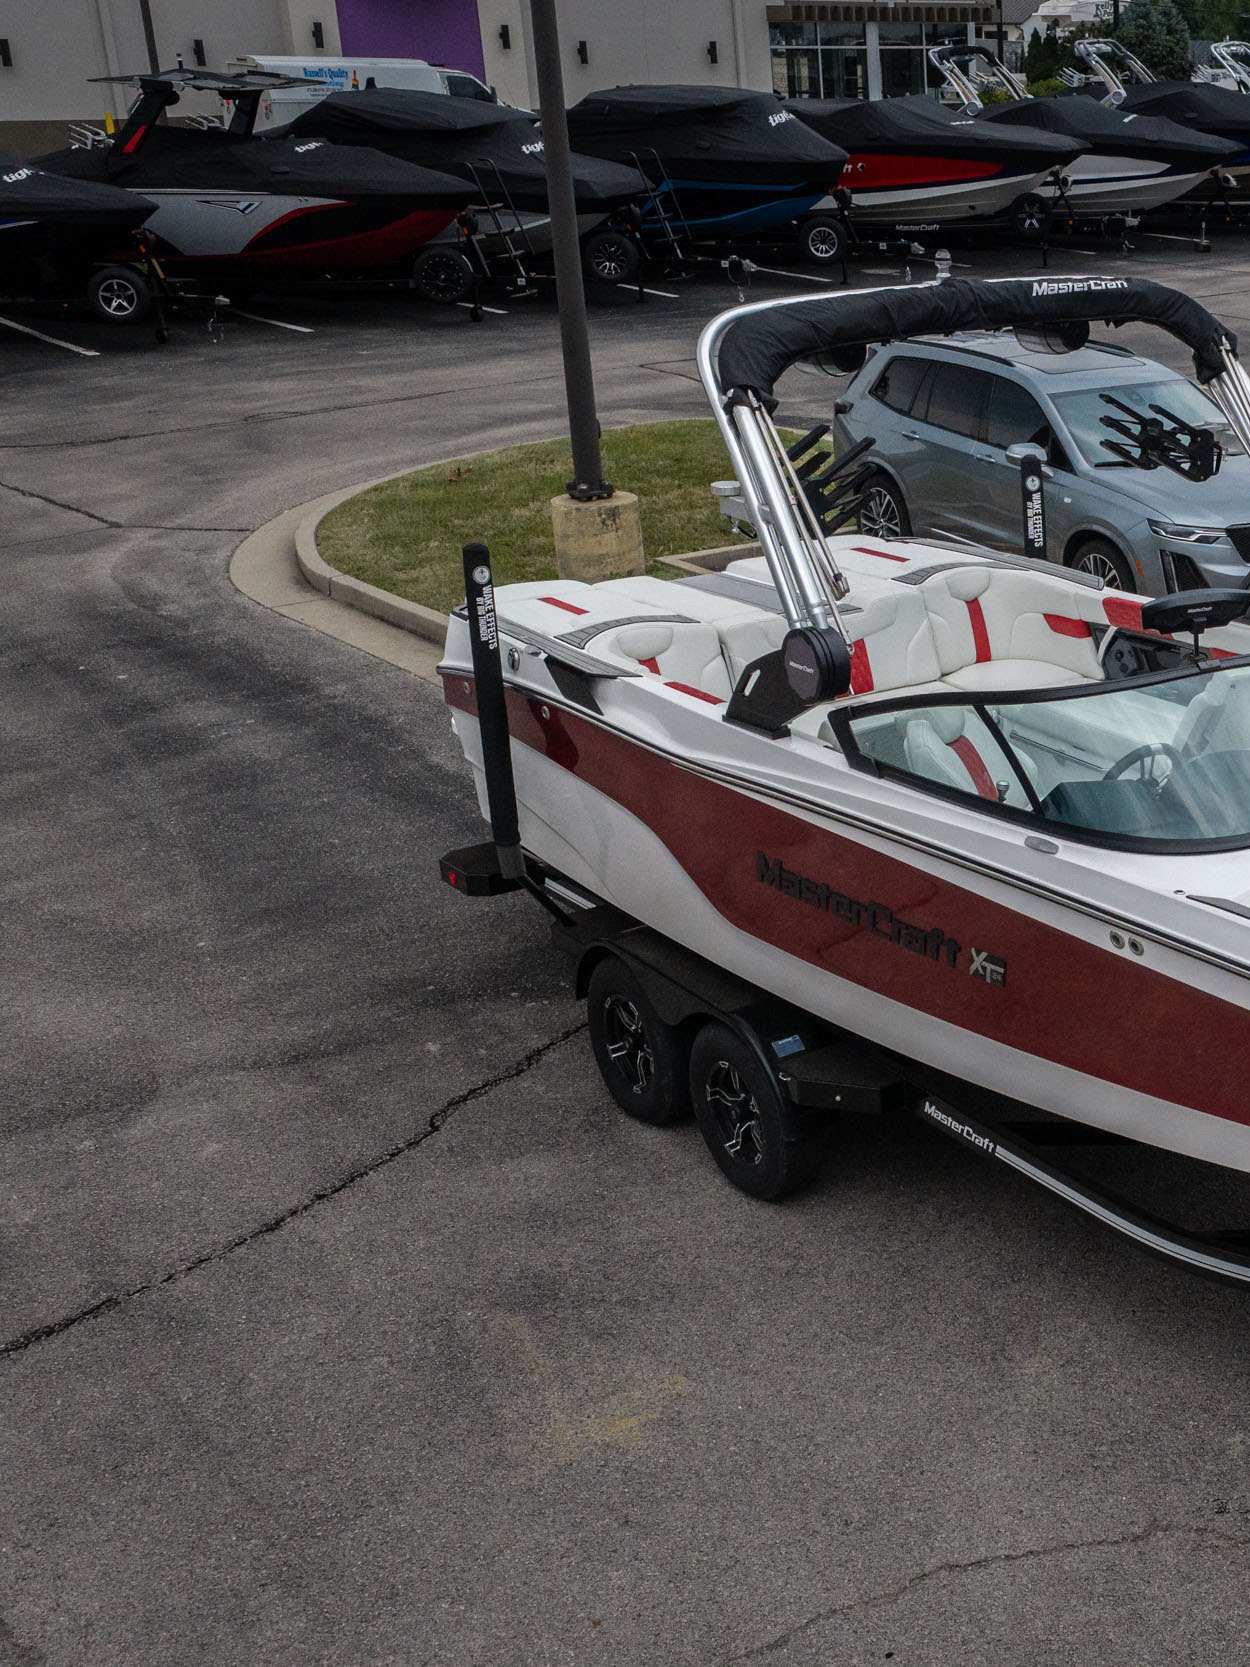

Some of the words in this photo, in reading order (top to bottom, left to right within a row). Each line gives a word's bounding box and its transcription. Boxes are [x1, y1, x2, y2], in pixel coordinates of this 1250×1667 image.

[1031, 492, 1042, 514] WAKE
[1033, 515, 1043, 547] EFFECTS
[475, 597, 484, 605] BY
[477, 605, 485, 616] BIG
[482, 584, 494, 613] WAKE
[478, 616, 489, 641] THUNDER
[485, 613, 498, 650] EFFECTS
[756, 850, 962, 968] MasterCraft
[924, 1101, 994, 1153] MasterCraft
